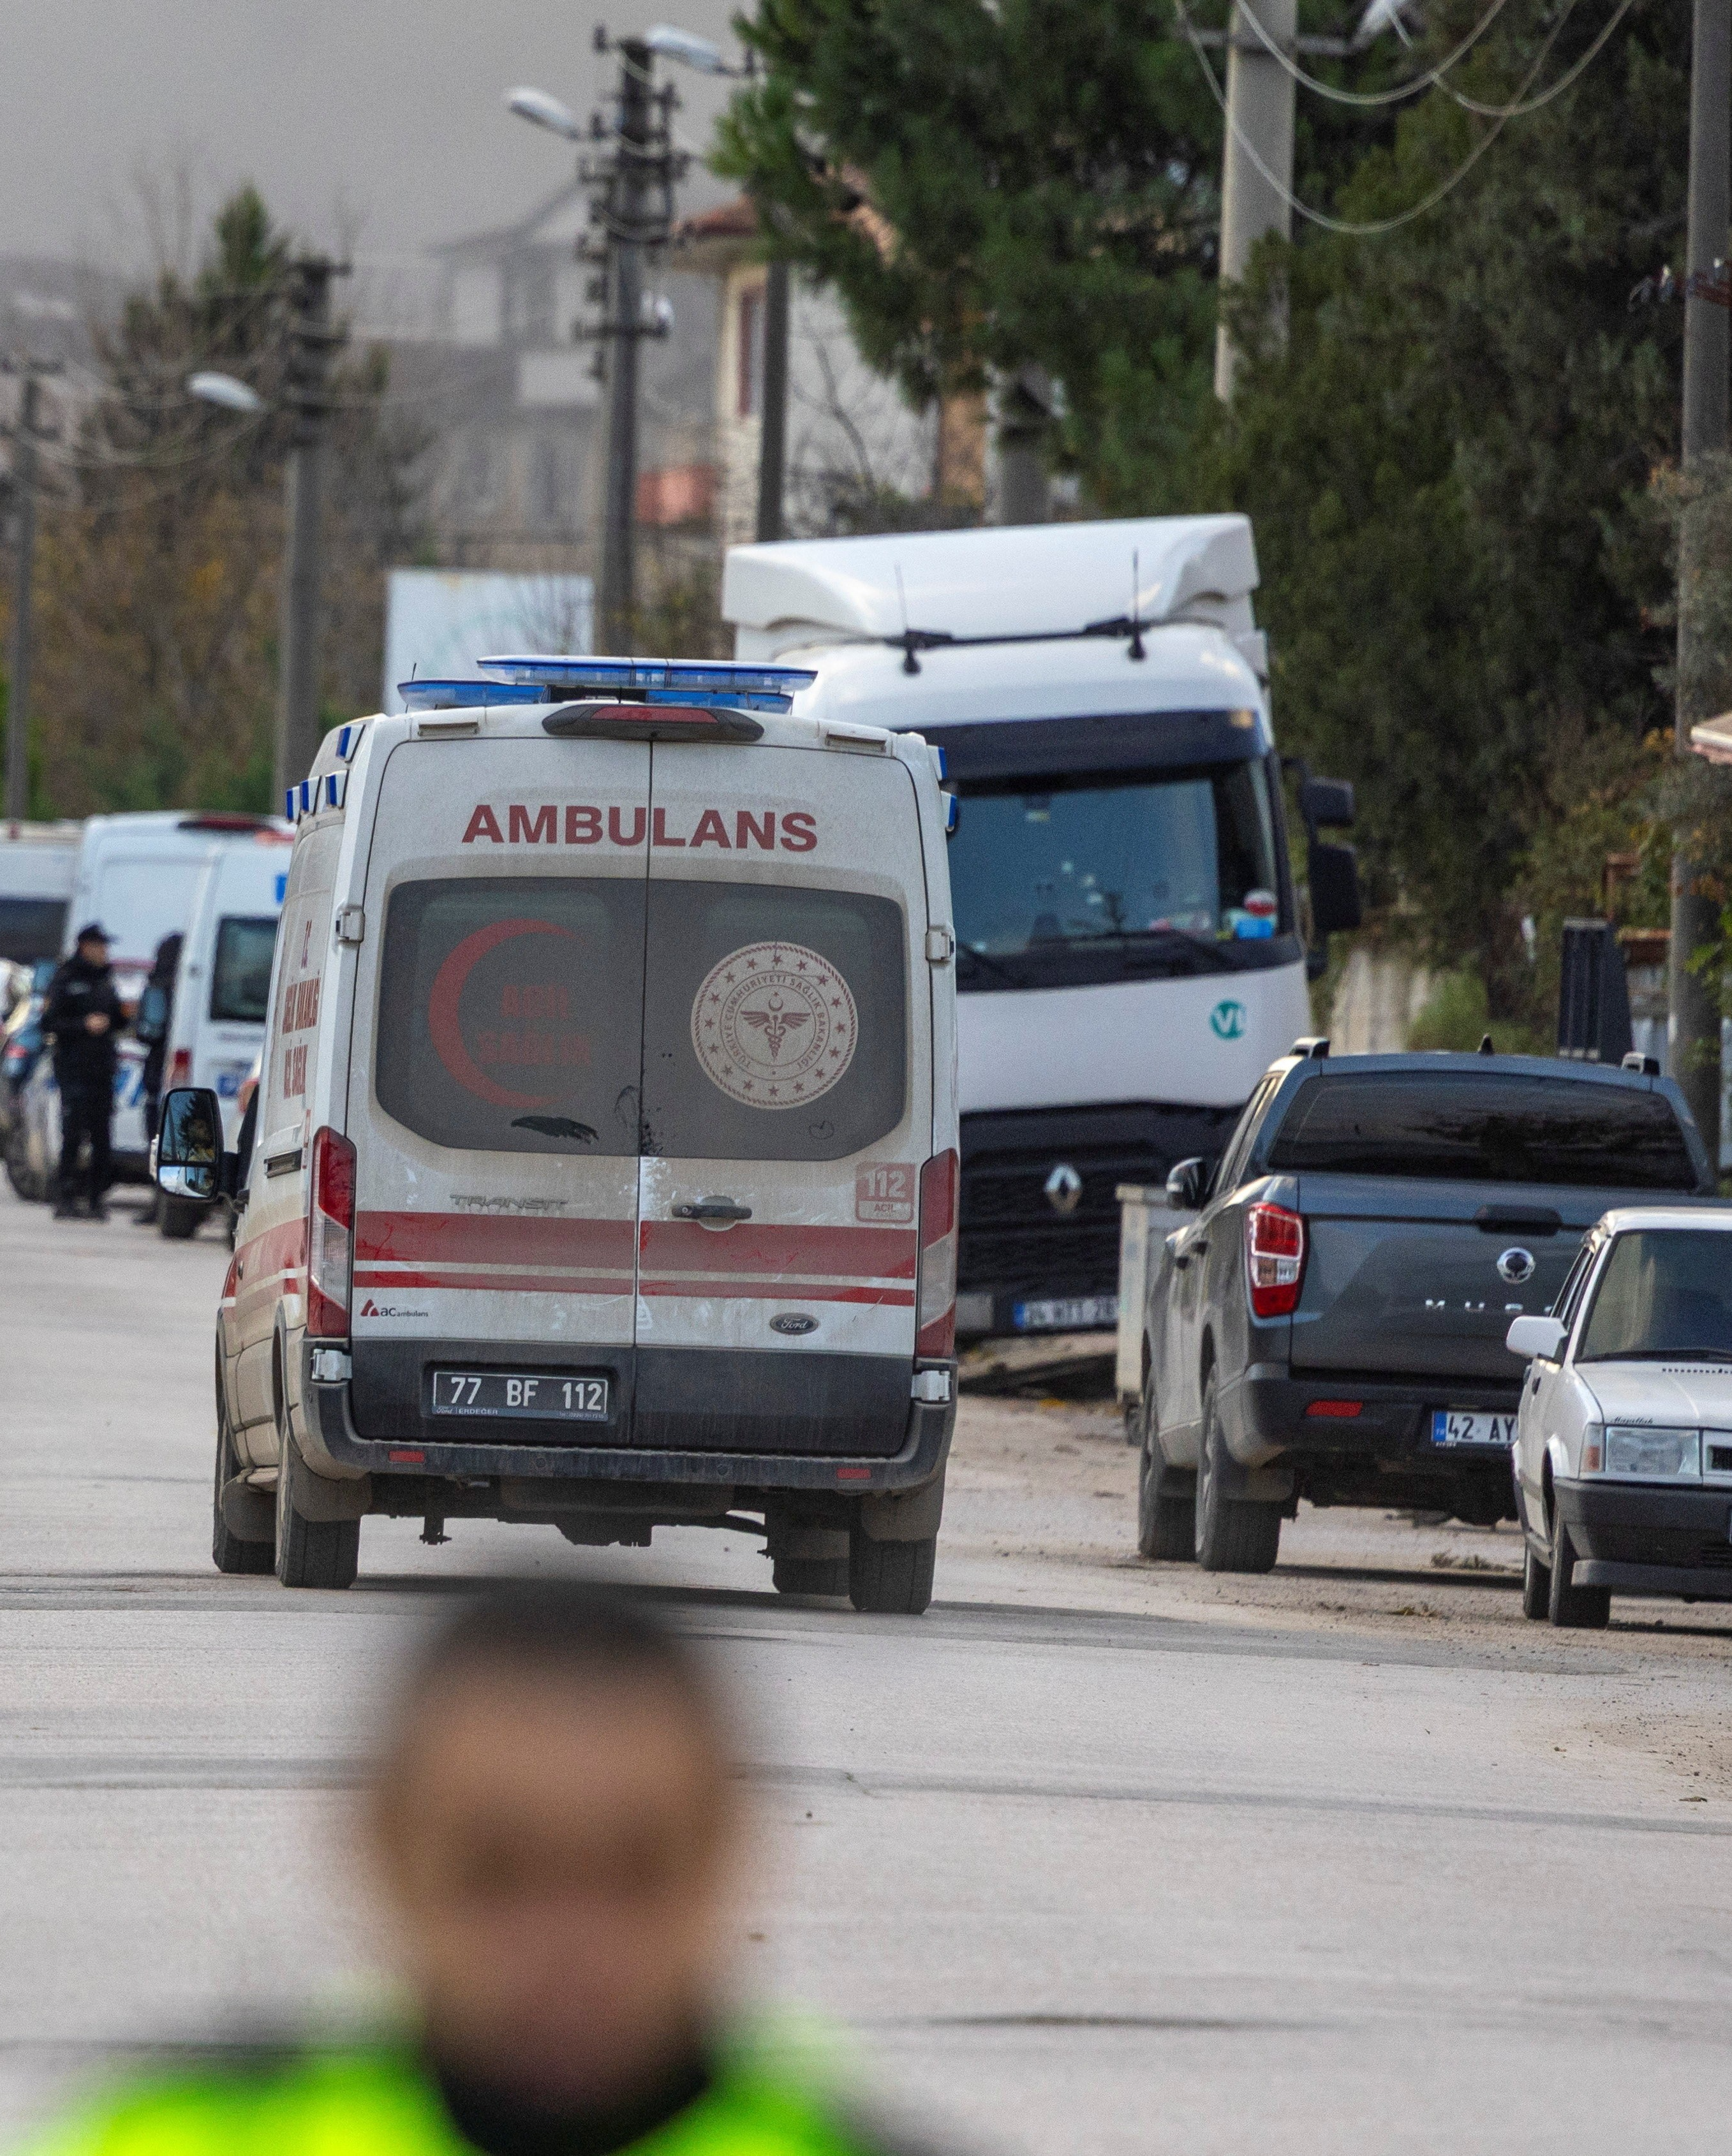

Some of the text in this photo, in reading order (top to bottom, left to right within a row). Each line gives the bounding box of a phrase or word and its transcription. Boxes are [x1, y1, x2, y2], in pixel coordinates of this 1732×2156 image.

[461, 804, 818, 853] AMBULANS
[863, 1169, 907, 1199] 112
[449, 1193, 569, 1211] TRANSIT
[780, 1318, 808, 1330] Ford
[450, 1377, 603, 1411] 77 BF 112
[1448, 1415, 1475, 1440] 42
